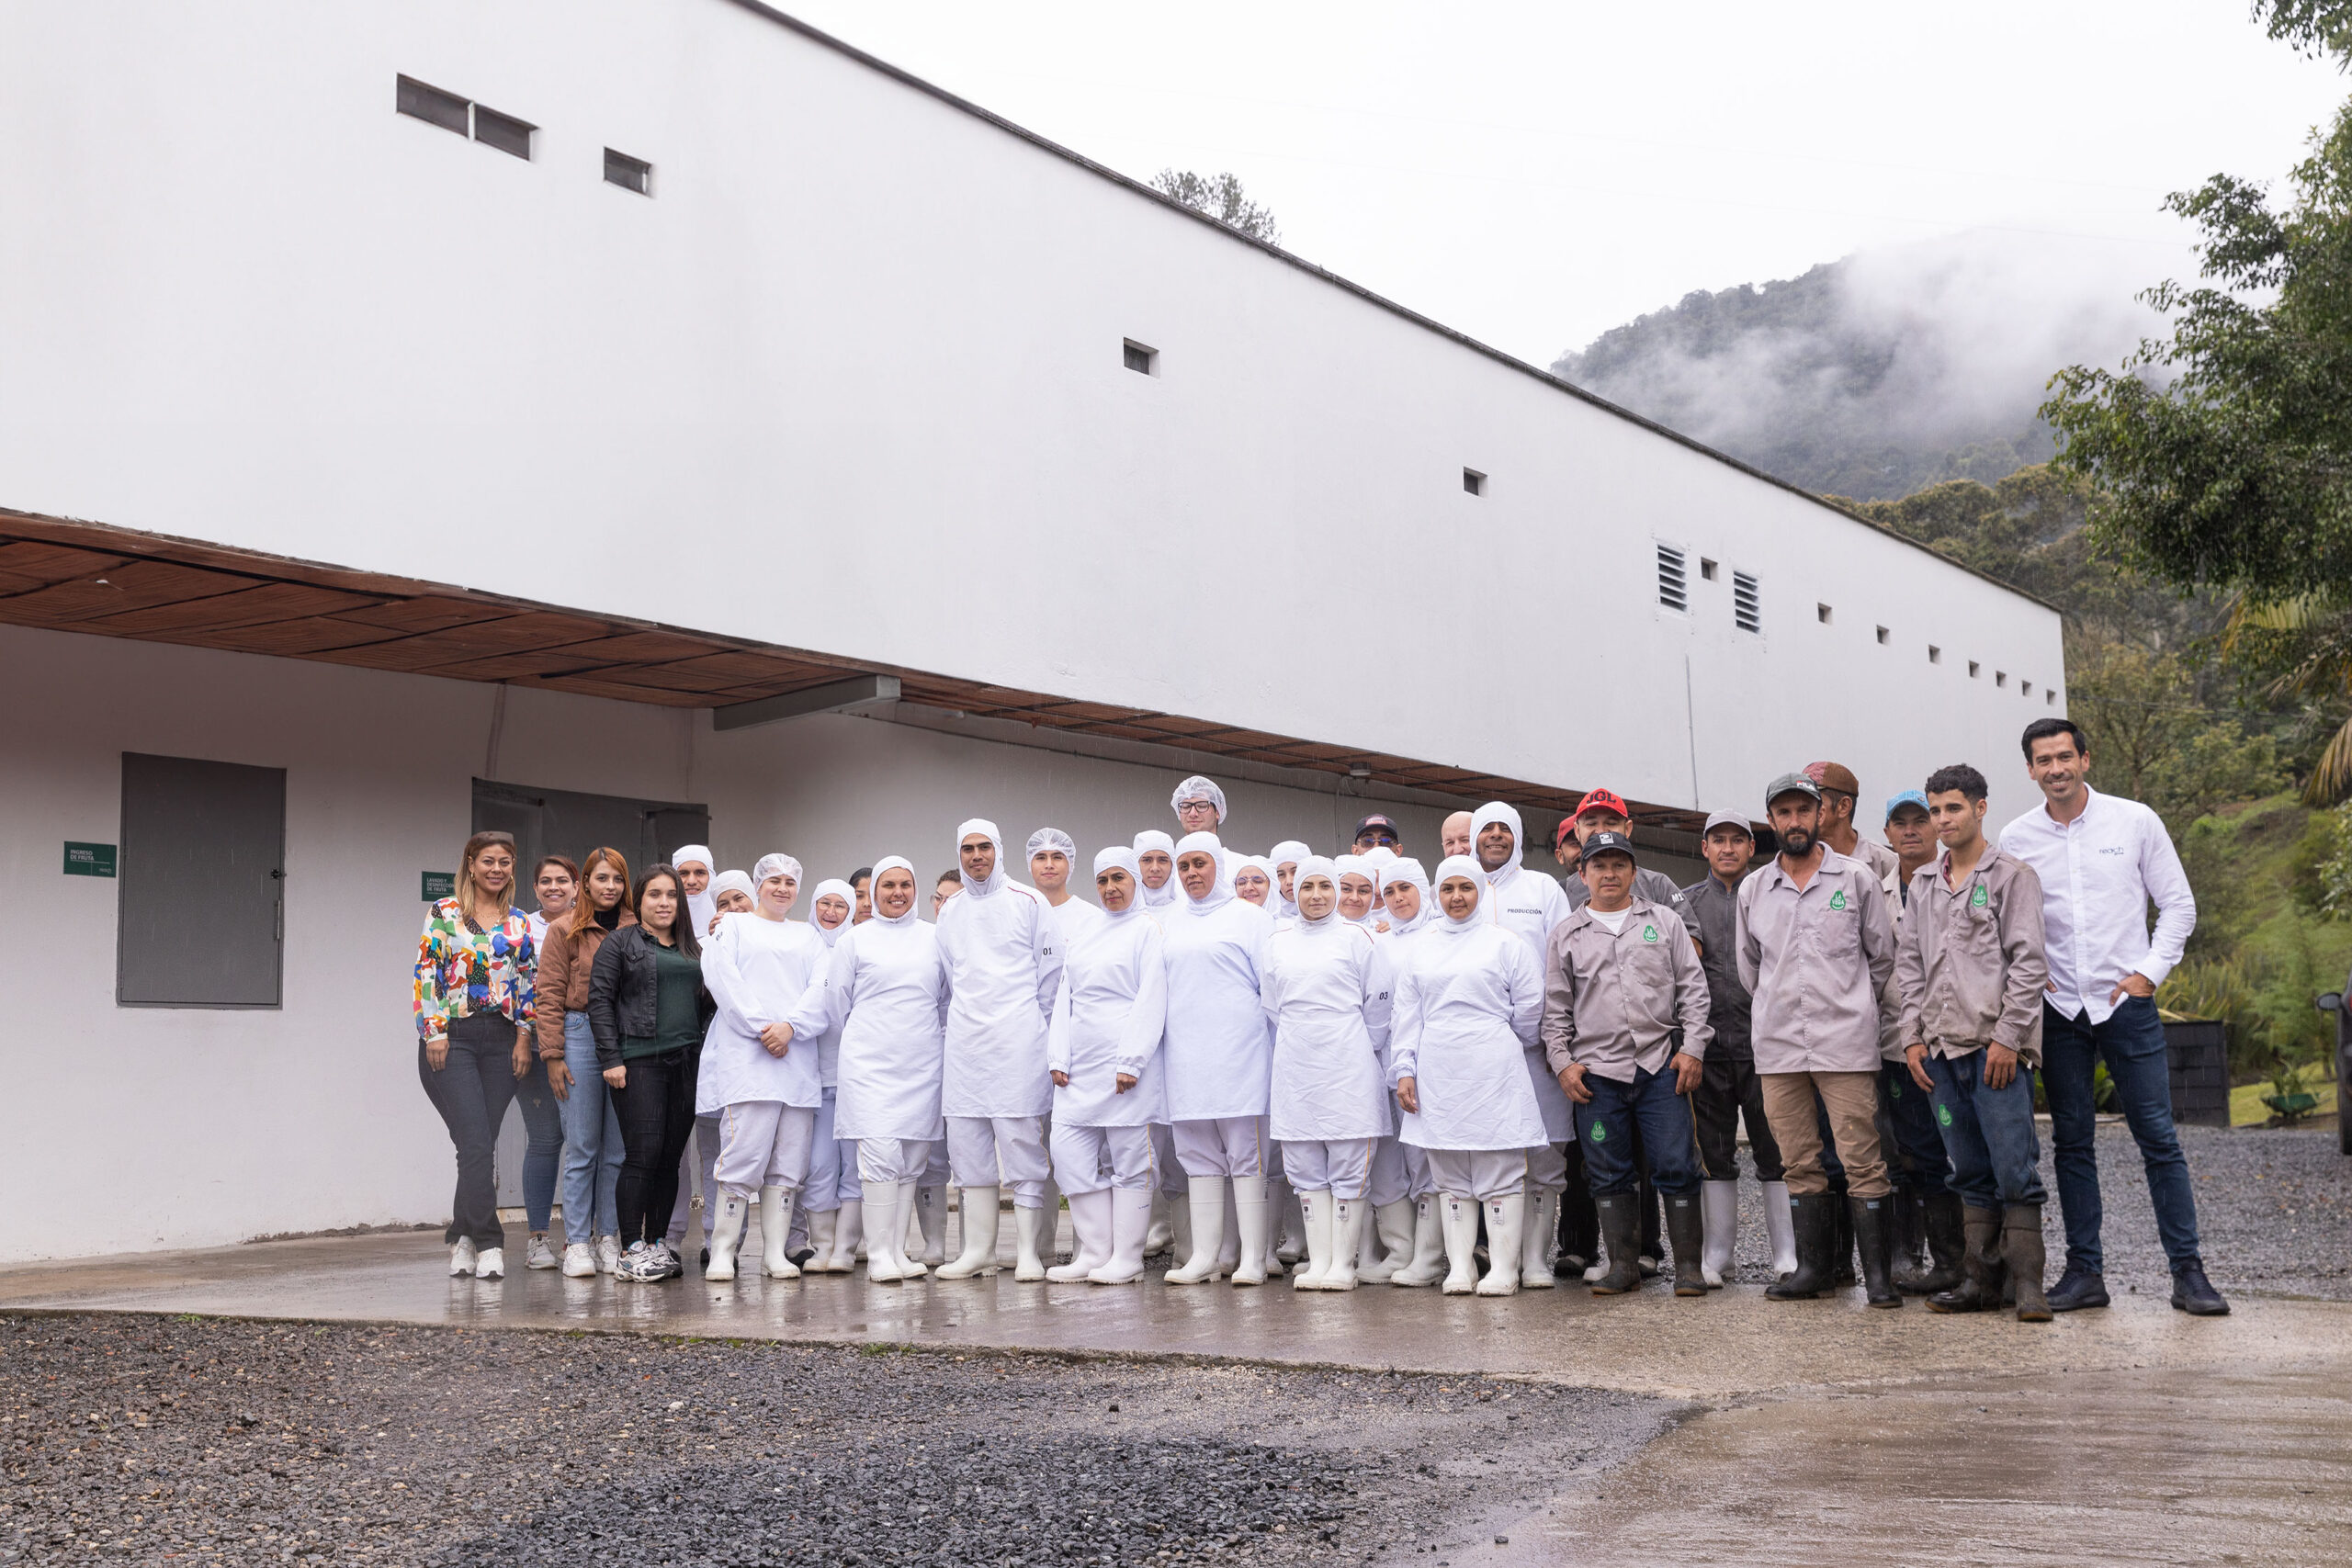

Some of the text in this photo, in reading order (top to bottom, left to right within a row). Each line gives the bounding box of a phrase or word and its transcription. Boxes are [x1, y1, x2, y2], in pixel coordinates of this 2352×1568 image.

[1586, 790, 1617, 804] JGL
[1043, 947, 1053, 955] 01
[1379, 991, 1388, 1000] 03
